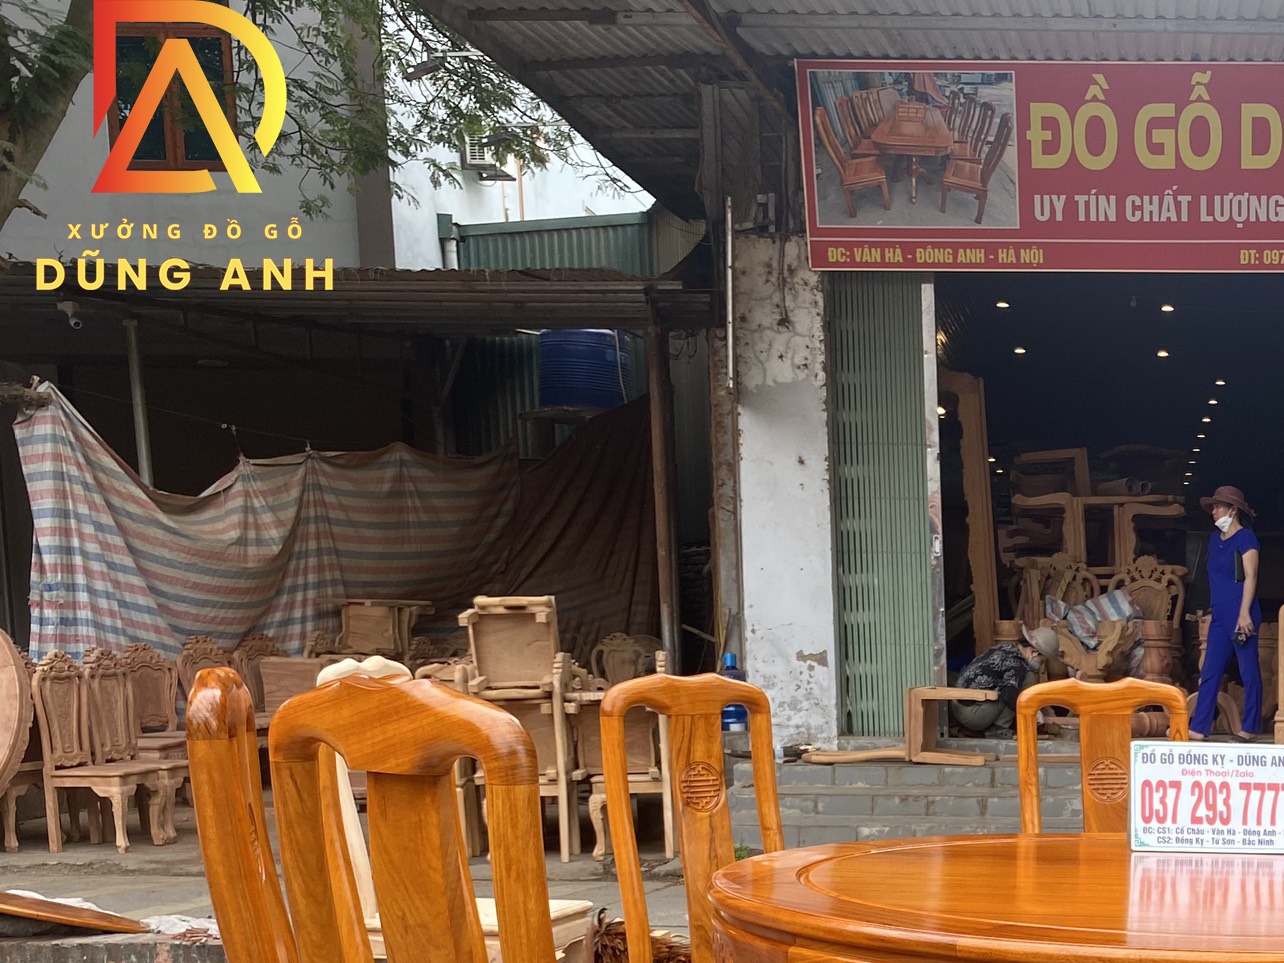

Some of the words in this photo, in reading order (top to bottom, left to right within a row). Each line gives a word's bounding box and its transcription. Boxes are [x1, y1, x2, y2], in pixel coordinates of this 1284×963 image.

[1026, 73, 1118, 170] ĐỒ
[1134, 70, 1222, 171] GỖ
[1033, 195, 1067, 222] UY
[1074, 189, 1117, 222] TÍN
[1125, 185, 1192, 223] CHẤT
[1200, 192, 1284, 228] LƯỢNG
[827, 247, 850, 262] ĐC:
[853, 245, 881, 263] VÂN
[884, 245, 903, 263] HÀ
[916, 245, 953, 263] ĐÔNG
[957, 248, 985, 263] ANH
[998, 246, 1016, 264] HÀ
[1020, 246, 1044, 267] NỘI
[1239, 249, 1259, 265] ĐT:
[1141, 749, 1156, 765] ĐỒ
[1160, 750, 1174, 765] GỖ
[1178, 751, 1208, 766] ĐỒNG
[1212, 753, 1226, 769] KỴ
[1237, 752, 1267, 767] DŨNG
[1181, 768, 1202, 778] Điện
[1140, 779, 1182, 825] 037
[1190, 780, 1232, 826] 293
[1258, 838, 1275, 846] Ninh
[1263, 828, 1277, 837] Anh
